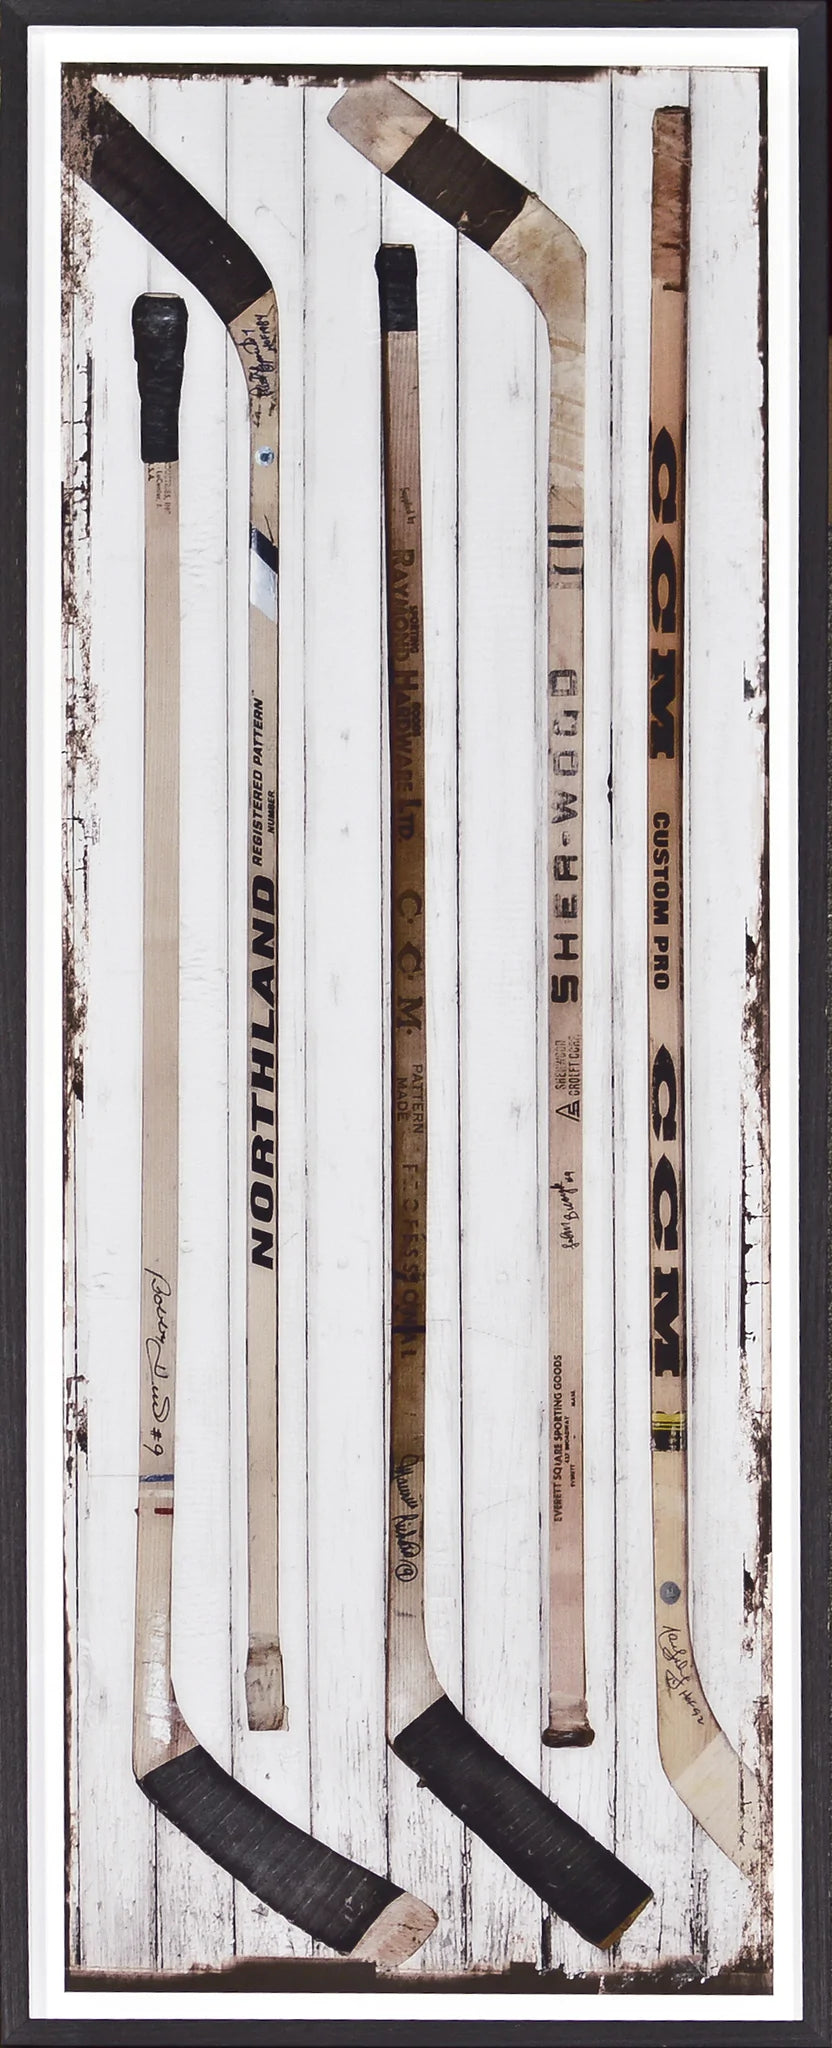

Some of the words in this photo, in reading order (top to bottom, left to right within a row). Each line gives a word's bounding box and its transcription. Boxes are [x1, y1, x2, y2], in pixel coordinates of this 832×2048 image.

[651, 427, 679, 761] CCM
[252, 698, 264, 766] PATTERN
[252, 771, 263, 867] REGISTERED
[267, 790, 275, 834] NUMBER
[653, 812, 670, 925] CUSTOM
[654, 936, 670, 990] PRO
[249, 874, 275, 1271] NORTHLAND
[397, 1077, 409, 1122] MADE
[412, 1064, 425, 1134] PATTERN
[651, 1043, 680, 1378] CCM
[553, 1355, 563, 1391] GOODS
[553, 1393, 563, 1442] SPORTING
